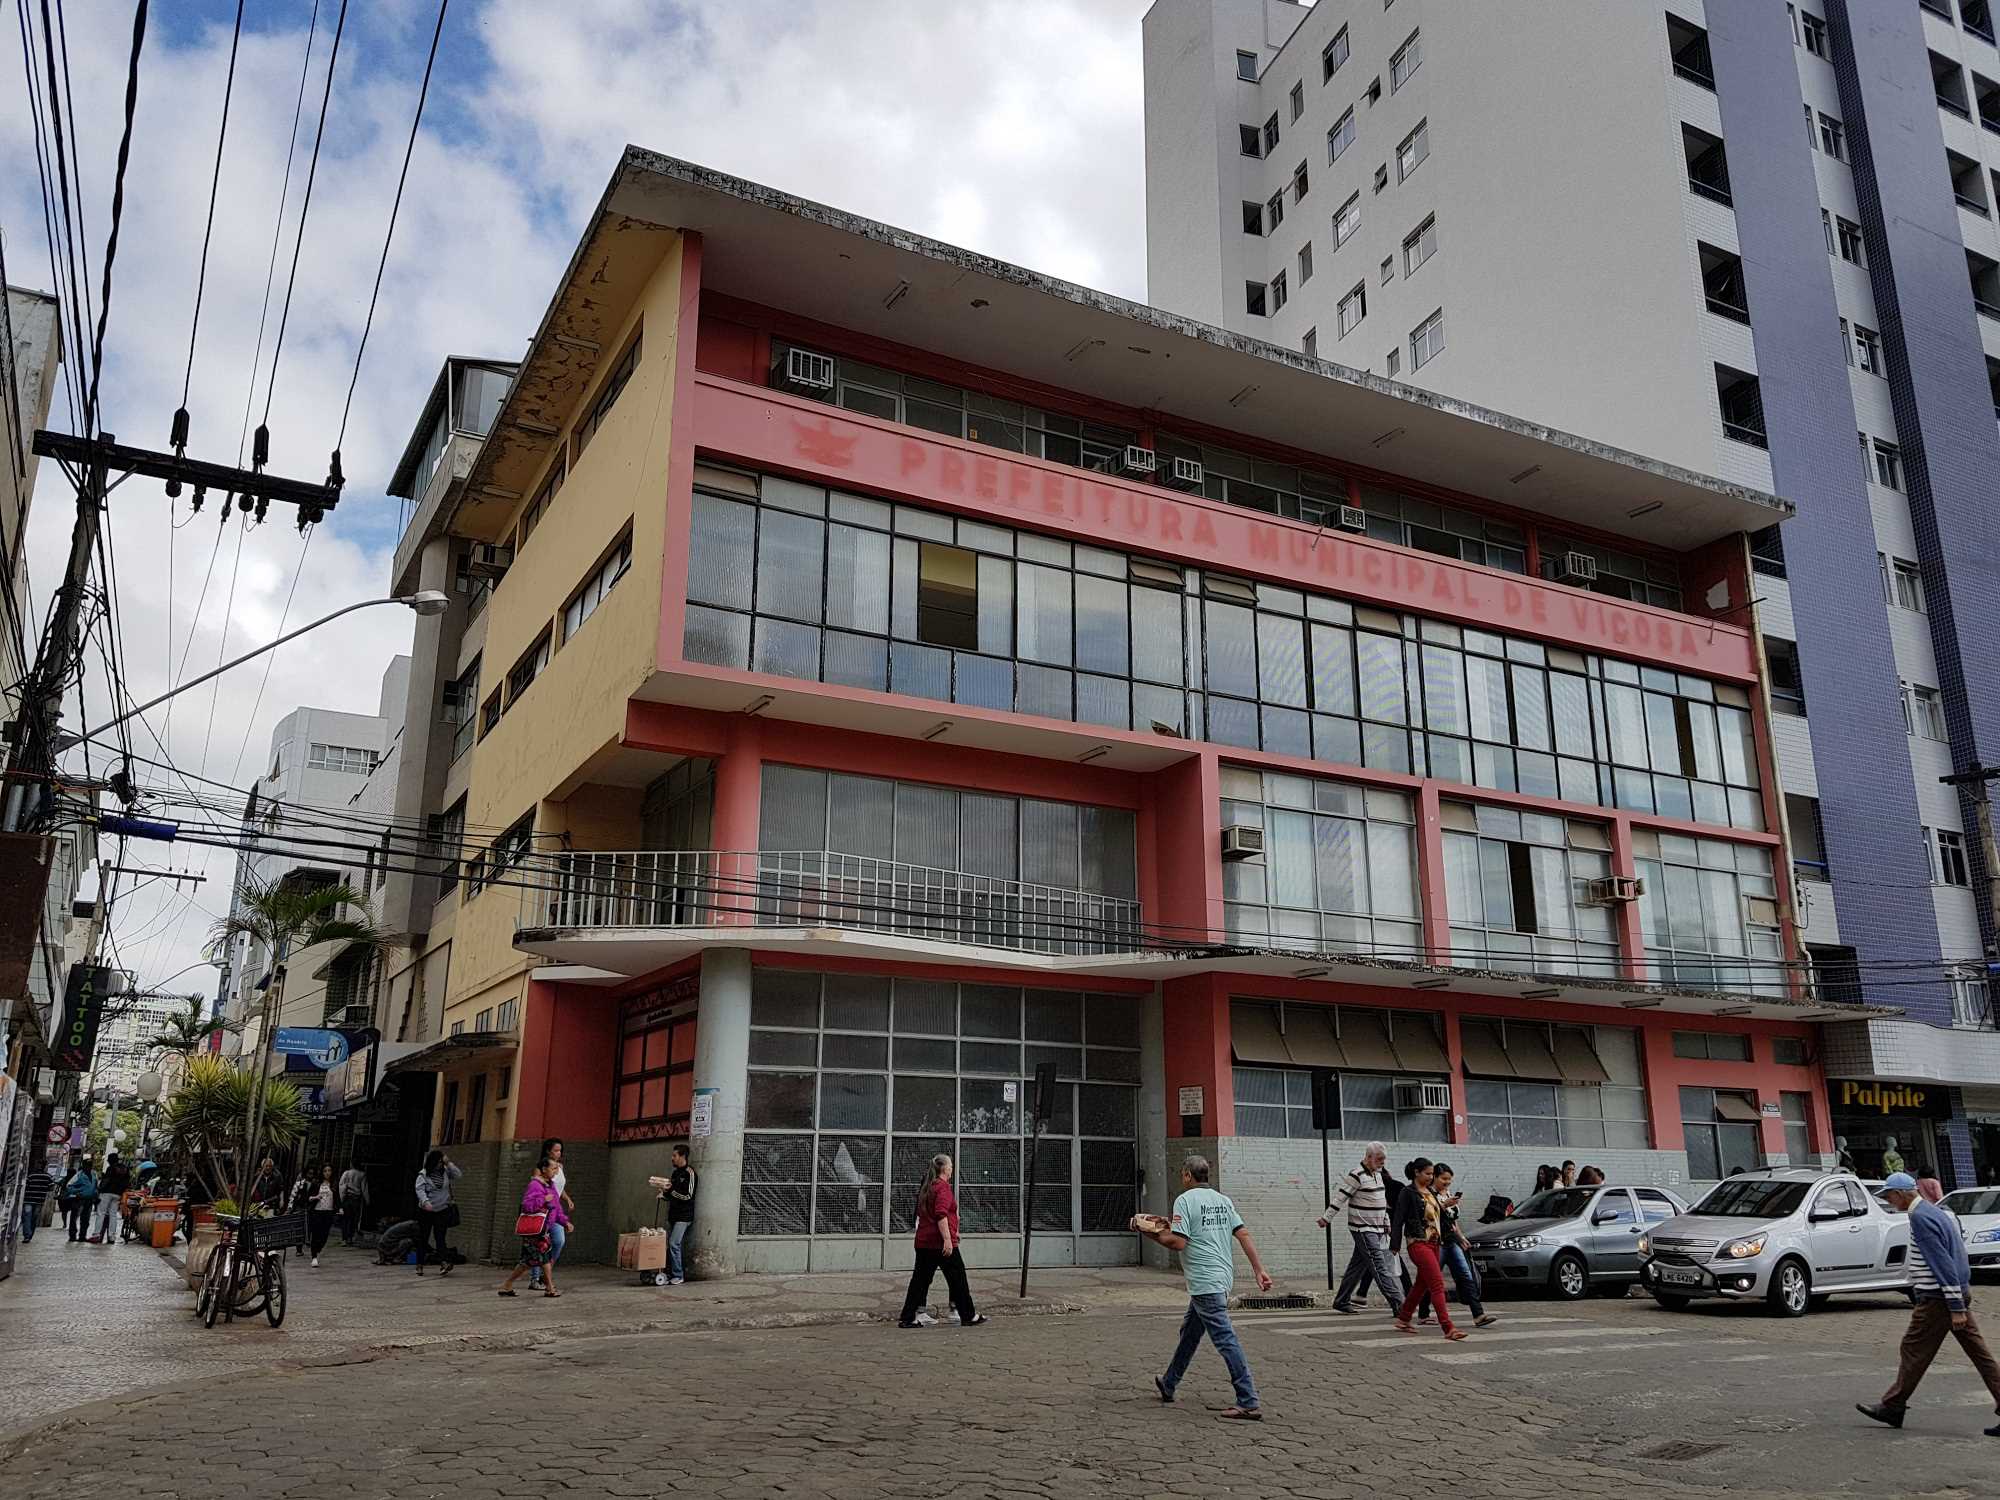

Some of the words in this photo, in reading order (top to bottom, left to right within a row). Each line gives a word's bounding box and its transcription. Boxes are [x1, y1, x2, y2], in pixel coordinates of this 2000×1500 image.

[901, 443, 1217, 546] PREFEITURA
[1249, 525, 1478, 609] MUNICIPAL
[1503, 582, 1547, 624] DE
[70, 967, 97, 1046] TATTOO
[1841, 1081, 1925, 1114] Palpite
[1200, 1203, 1228, 1215] Mercado
[1201, 1214, 1228, 1227] Familiar
